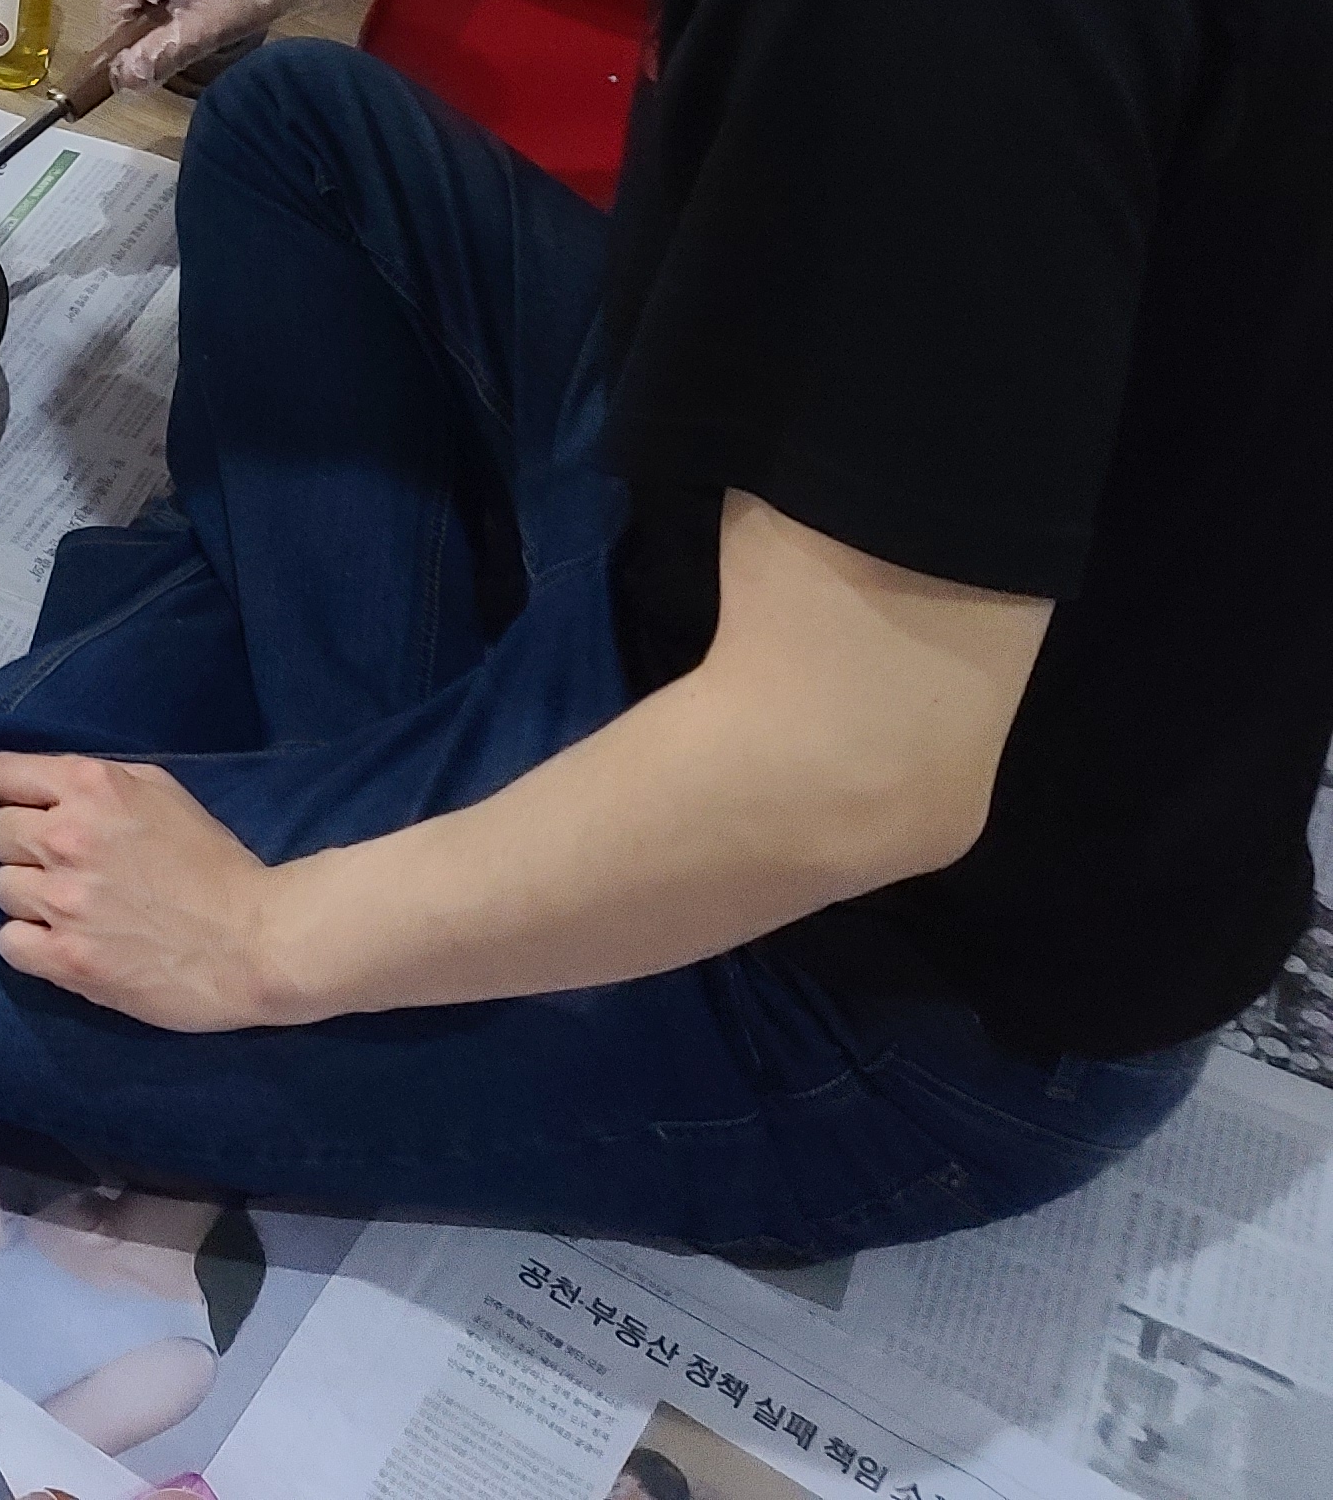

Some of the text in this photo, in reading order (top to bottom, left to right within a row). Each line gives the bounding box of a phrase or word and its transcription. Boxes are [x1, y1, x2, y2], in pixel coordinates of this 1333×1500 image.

[680, 1351, 751, 1410] 정책
[747, 1391, 820, 1451] 실패
[817, 1432, 891, 1493] 책임
